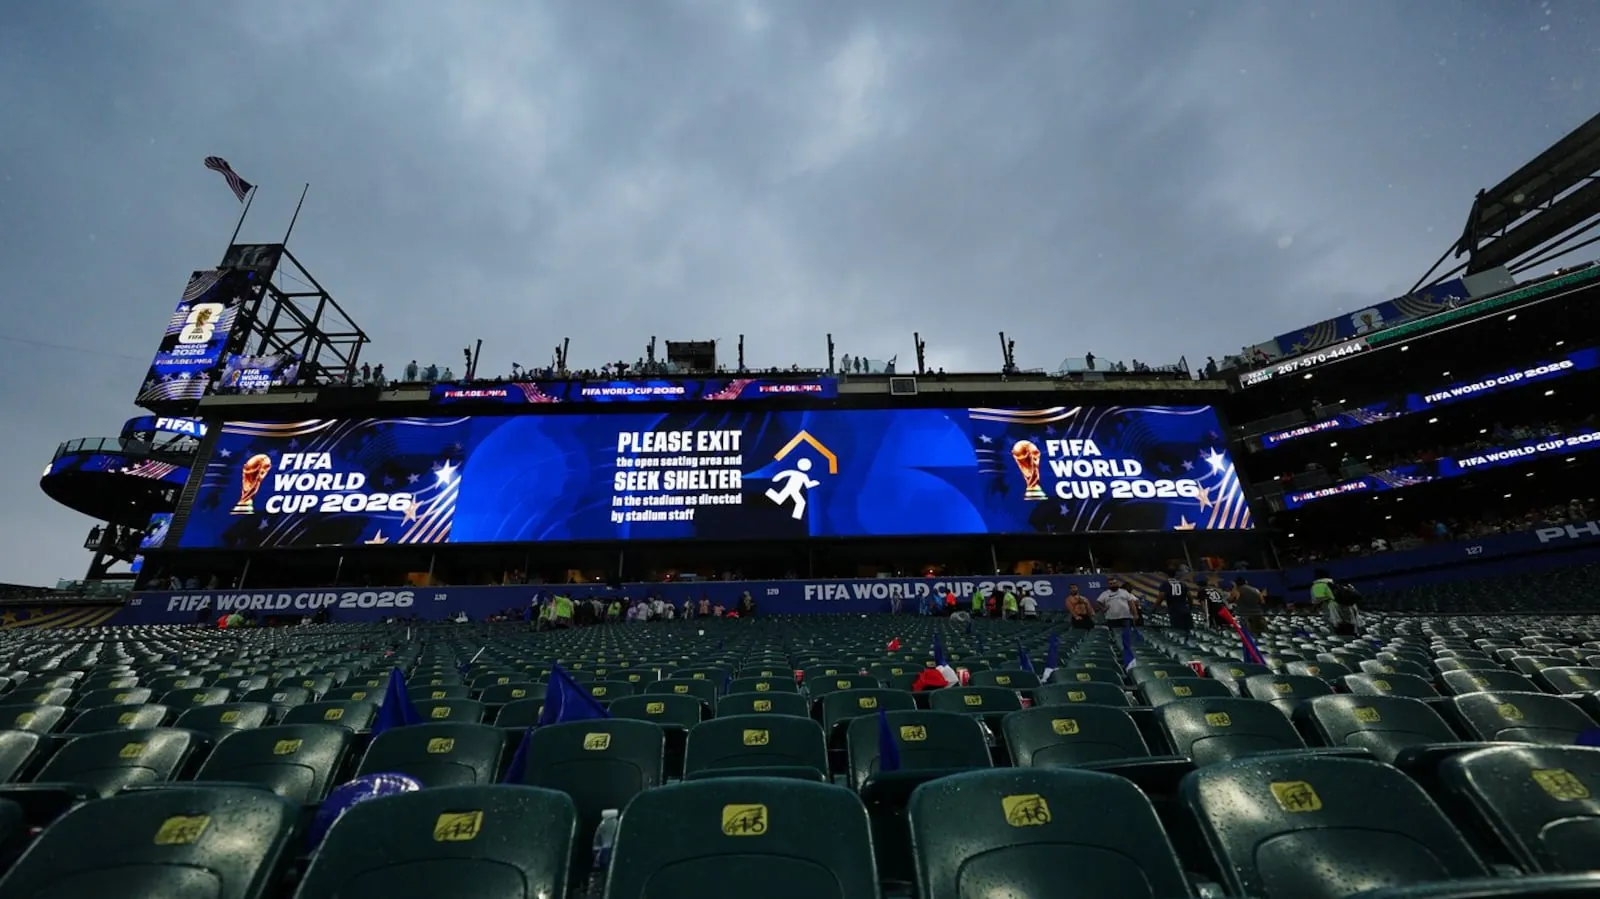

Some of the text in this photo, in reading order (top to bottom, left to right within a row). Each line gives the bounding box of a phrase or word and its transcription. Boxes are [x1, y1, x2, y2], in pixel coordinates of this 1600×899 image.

[171, 348, 206, 356] 2026
[1277, 342, 1362, 375] 267-570-4444
[582, 386, 685, 396] FIFA WORLD CUP 2026
[759, 384, 822, 393] PHILADELPHIA
[1425, 360, 1574, 404] FIFA WORLD CUP 2026
[445, 389, 507, 398] PHILADELPHIA
[156, 417, 196, 434] FIFA
[1269, 419, 1339, 443] PHILADELPHIA
[617, 430, 742, 453] PLEASE EXIT
[1045, 439, 1102, 457] FIFA
[1458, 431, 1600, 468] FIFA WORLD CUP 202
[278, 452, 332, 471] FIFA
[616, 454, 742, 469] the open seating area and
[1048, 459, 1142, 478] WORLD
[273, 472, 366, 492] WORLD
[614, 469, 742, 491] SEEK SHELTER
[1055, 478, 1200, 500] CUP 2026
[624, 494, 641, 506] the
[642, 494, 684, 506] stadium
[685, 495, 697, 506] as
[698, 493, 742, 505] directed
[1292, 480, 1367, 503] PHILADELPHIA
[265, 493, 412, 514] CUP 2026
[611, 508, 695, 524] by stadium staff
[804, 584, 850, 600] FIFA
[852, 582, 930, 599] WORLD
[933, 581, 974, 598] CUP
[1171, 582, 1182, 596] 10
[166, 591, 415, 612] FIFA WORLD CUP 2026
[738, 815, 766, 833] 15
[1023, 805, 1049, 824] 16
